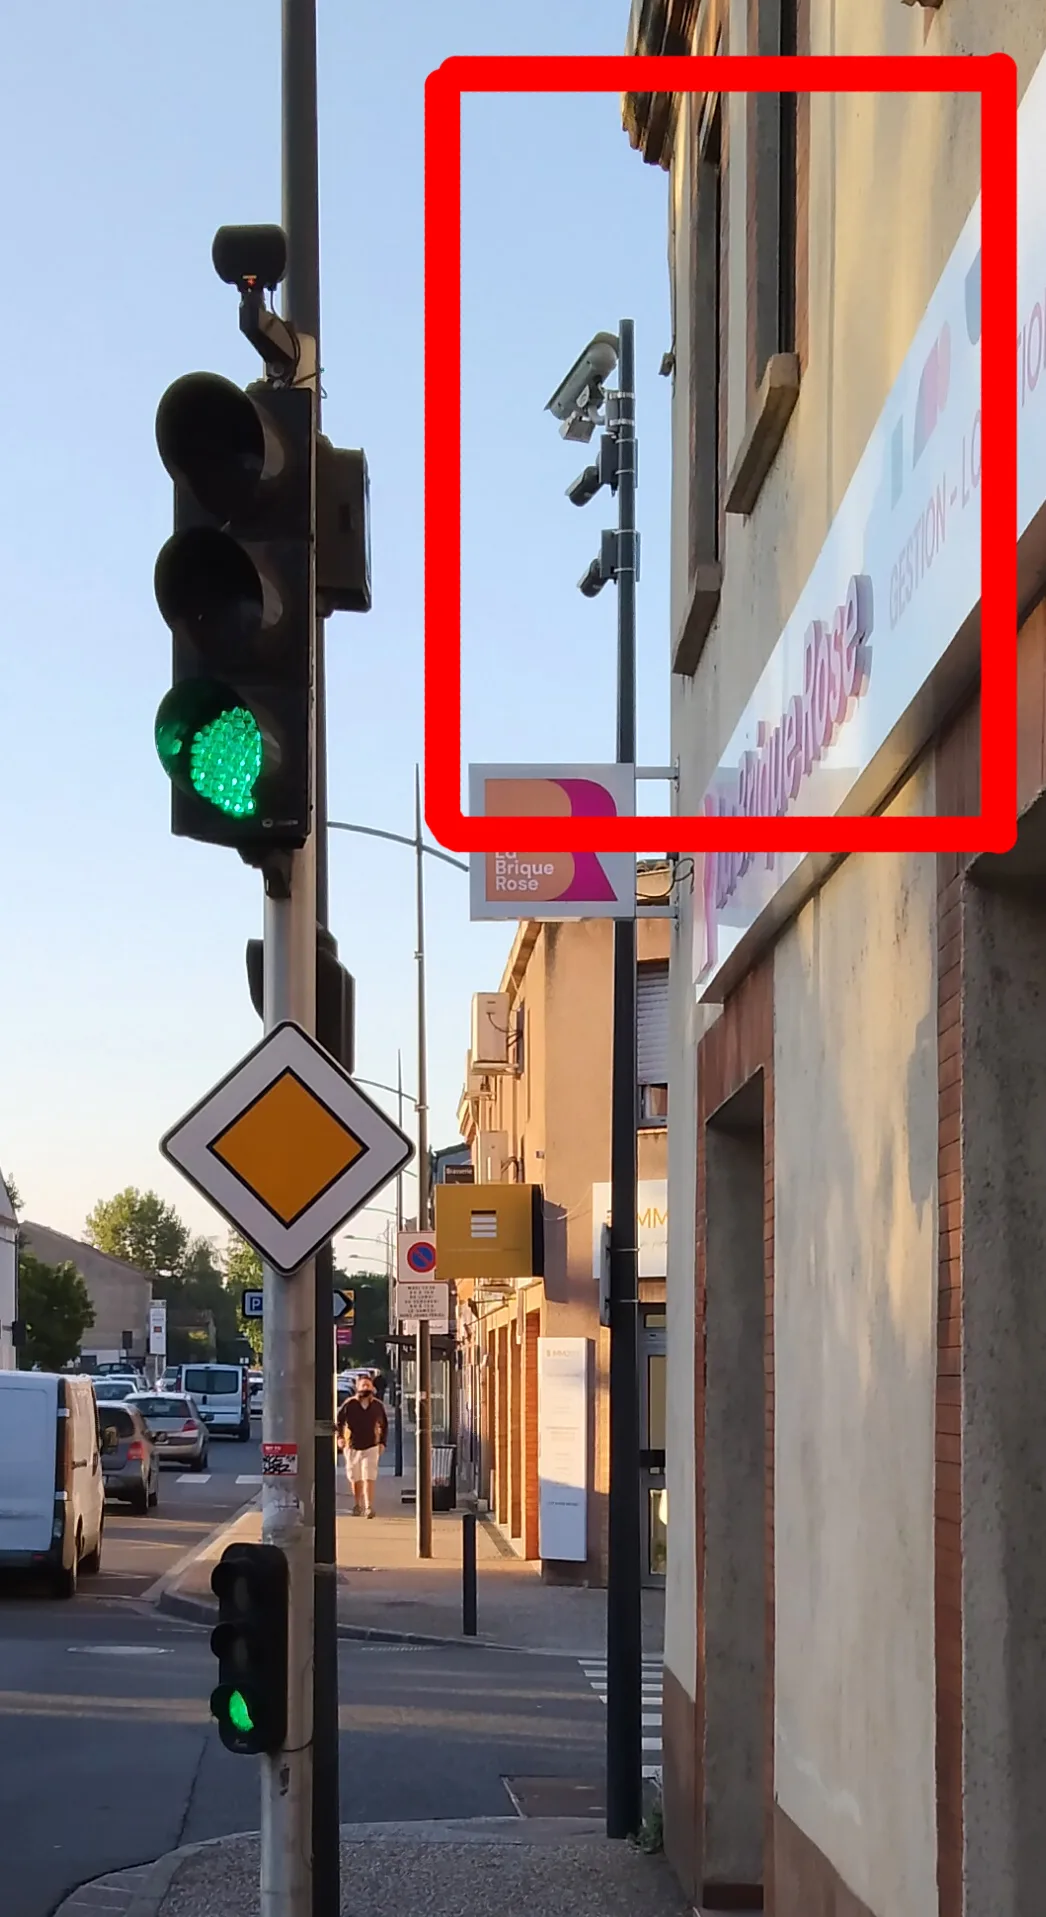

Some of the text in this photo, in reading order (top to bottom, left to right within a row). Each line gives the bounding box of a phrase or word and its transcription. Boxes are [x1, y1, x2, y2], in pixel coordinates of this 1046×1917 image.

[889, 471, 946, 631] GESTION
[802, 574, 873, 777] Rose
[496, 860, 554, 879] Brique
[496, 876, 539, 891] Rose
